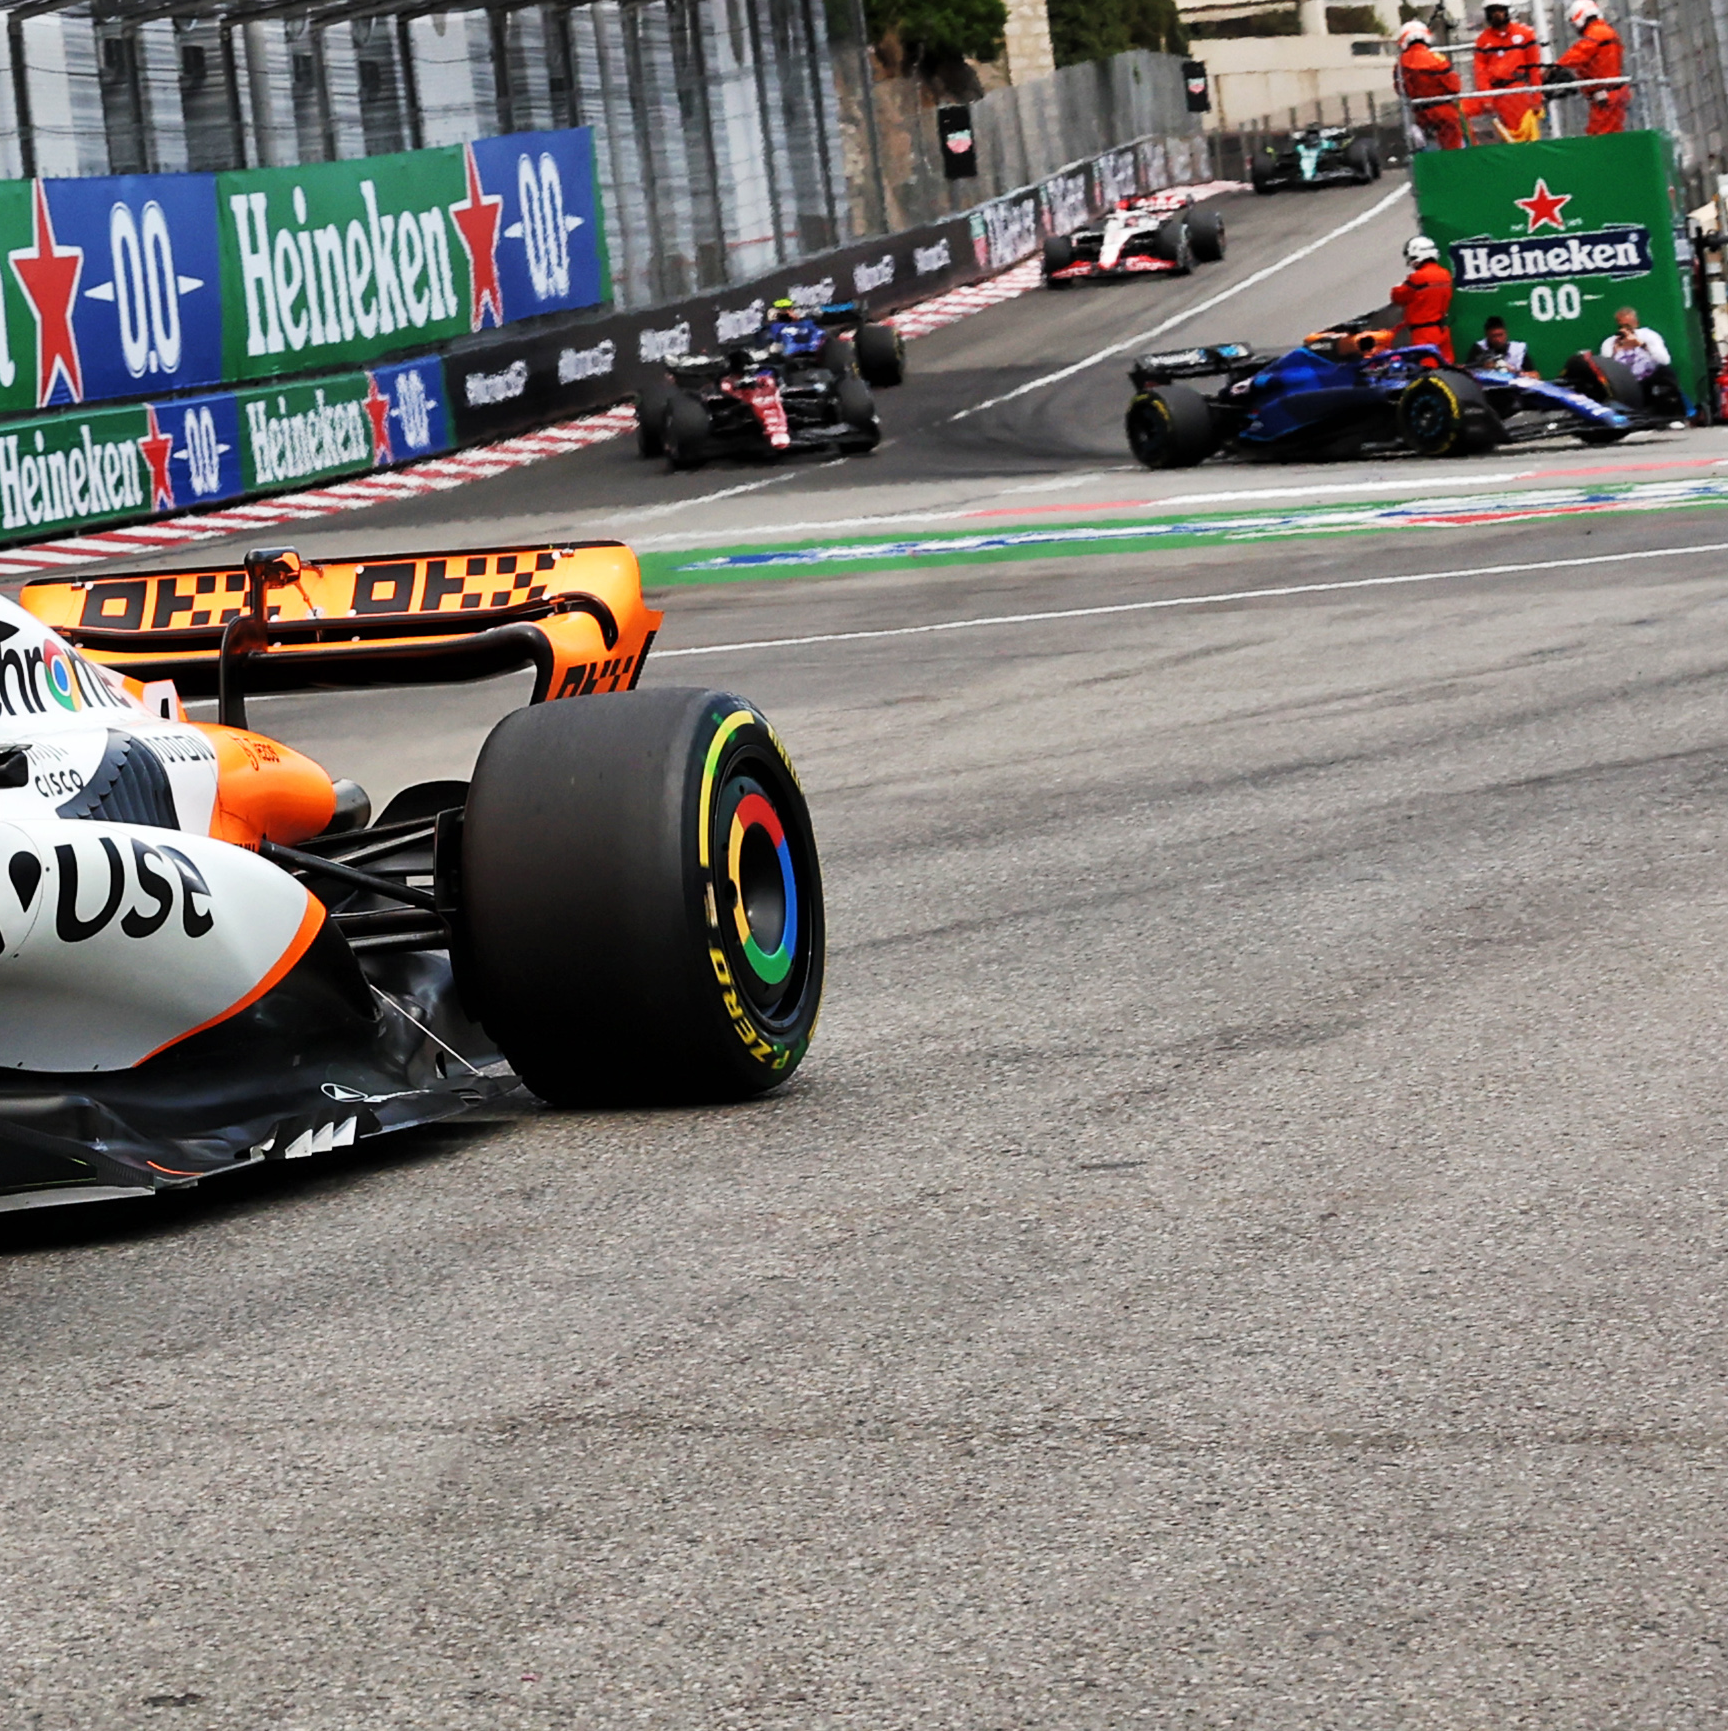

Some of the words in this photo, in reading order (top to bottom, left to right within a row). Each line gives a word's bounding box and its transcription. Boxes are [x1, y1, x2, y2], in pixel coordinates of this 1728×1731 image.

[105, 199, 183, 379] 0.0
[229, 180, 457, 357] Heineken
[1459, 239, 1641, 280] Heineken
[1530, 284, 1581, 321] 0.0
[249, 387, 366, 476] Heineken
[707, 947, 772, 1064] ZERO
